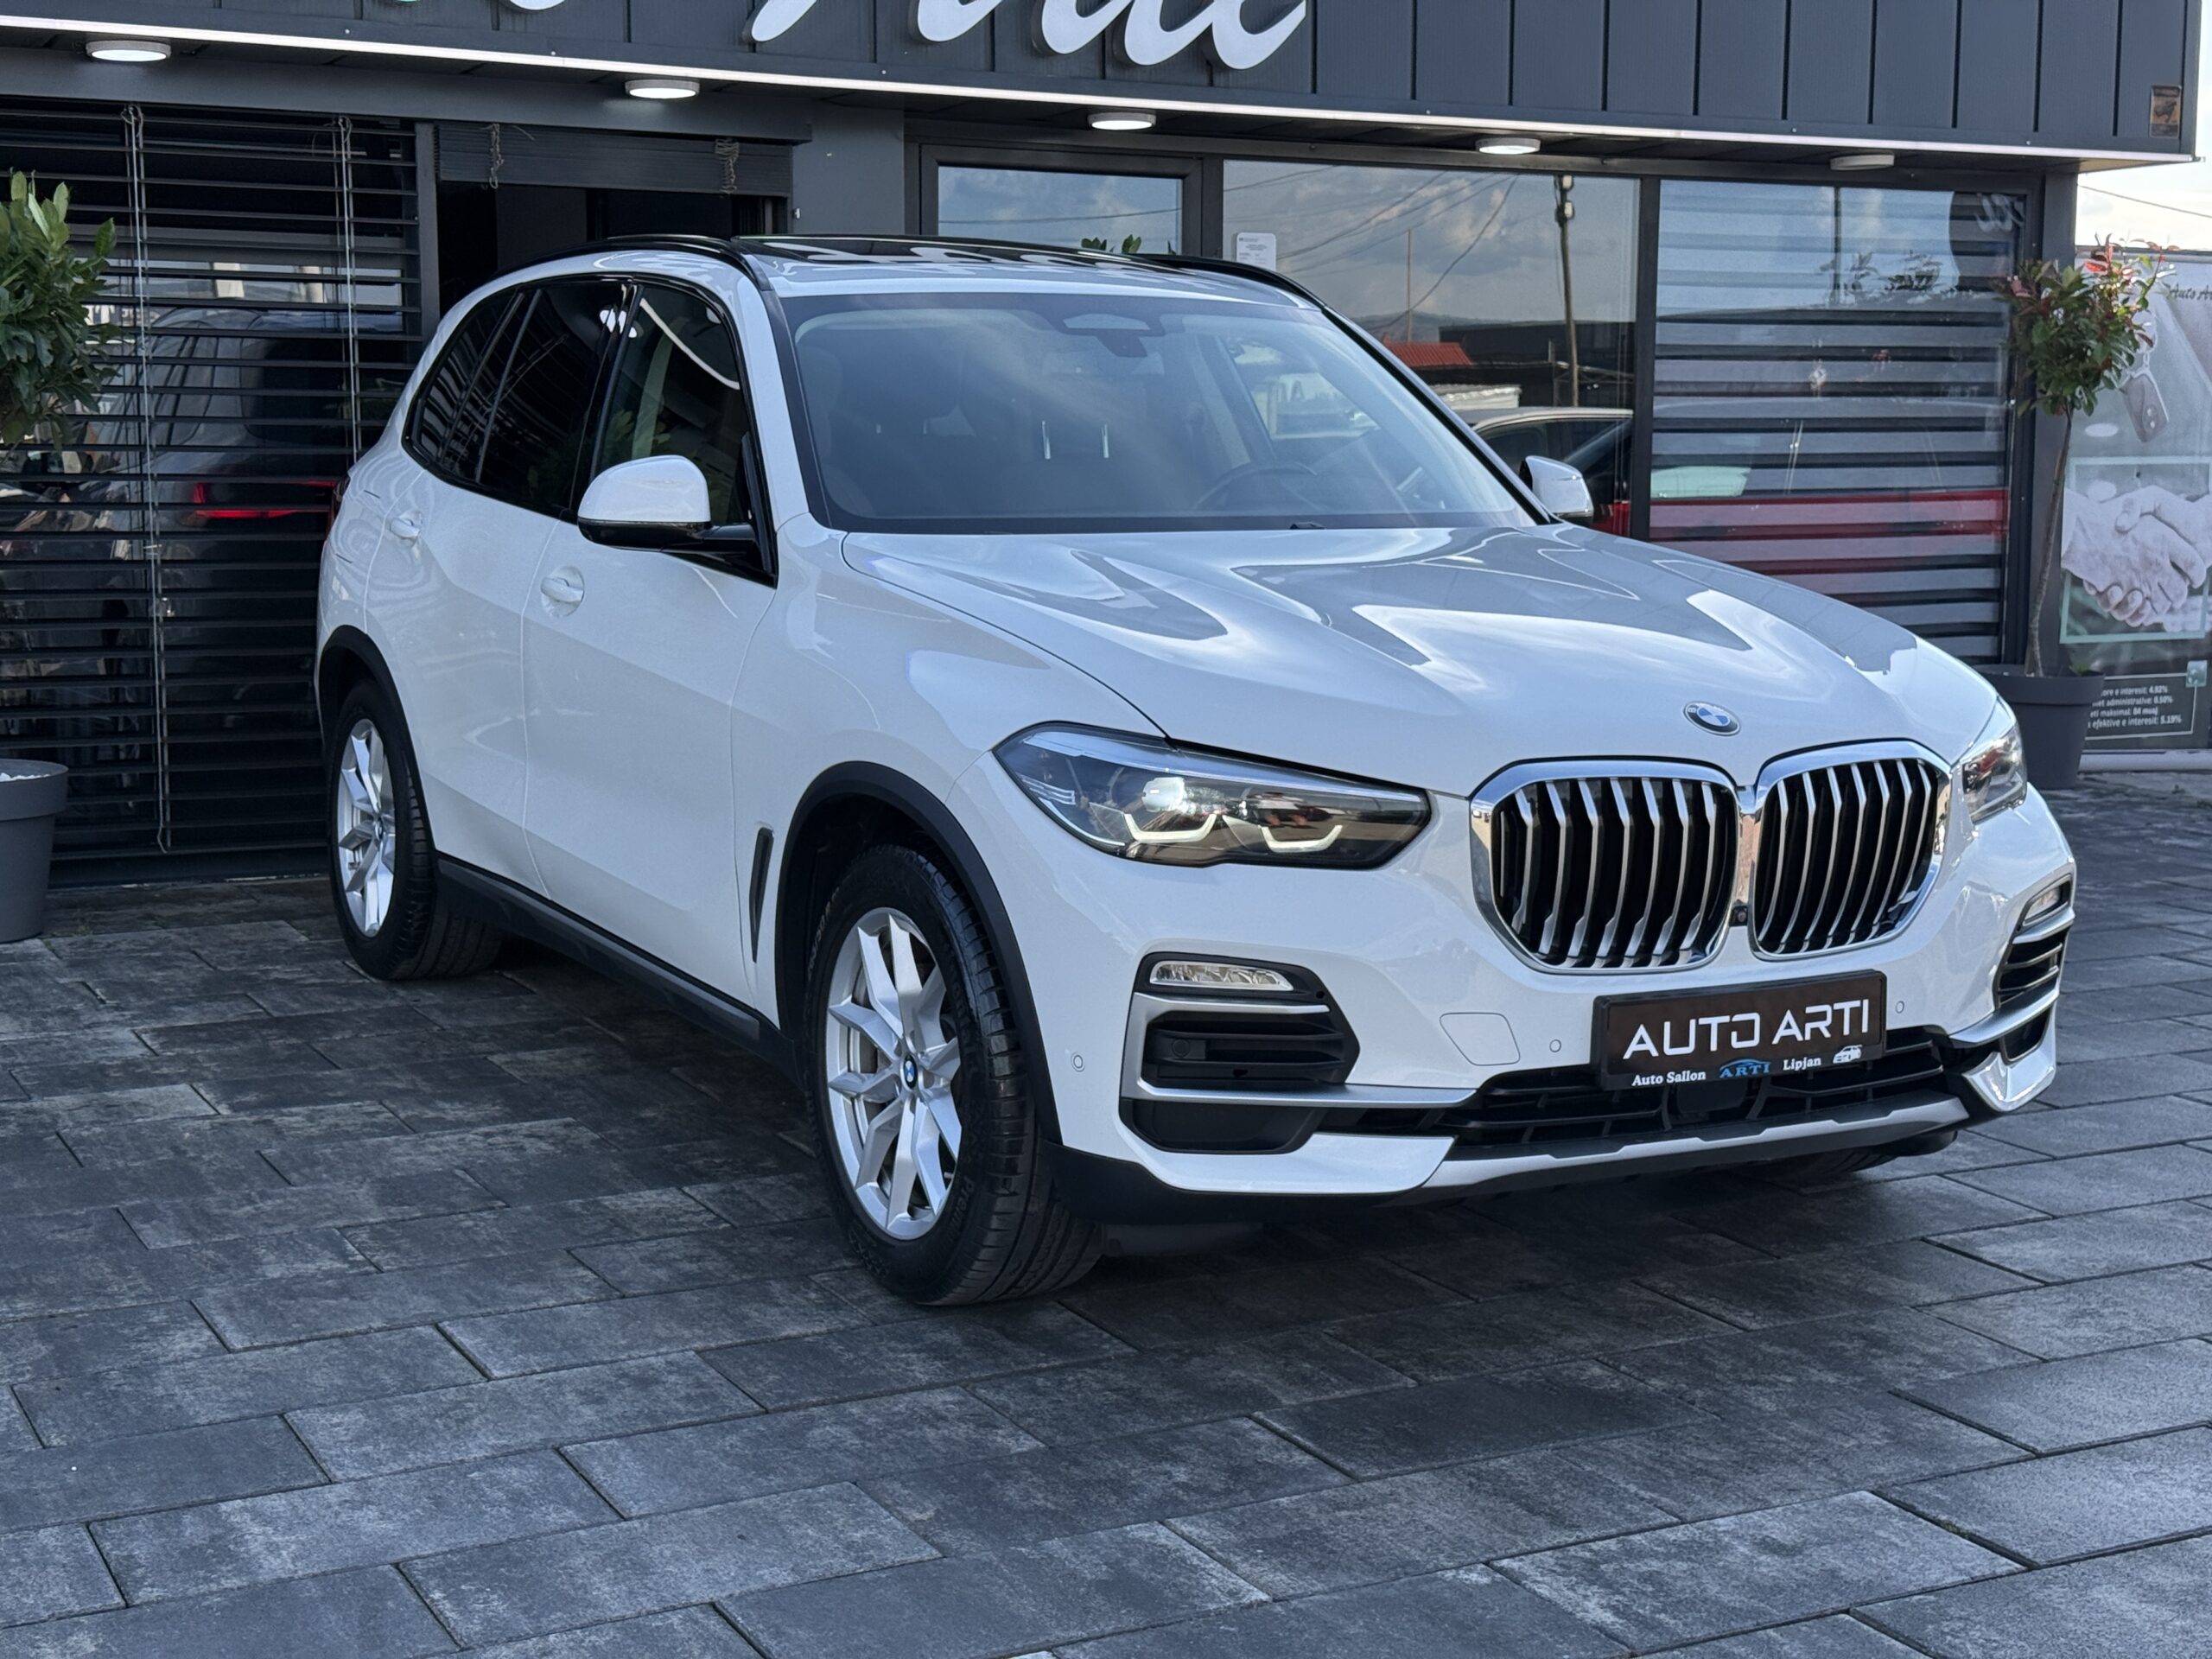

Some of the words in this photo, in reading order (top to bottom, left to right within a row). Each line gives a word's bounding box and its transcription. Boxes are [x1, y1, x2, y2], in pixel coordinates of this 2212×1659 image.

[1623, 1012, 1761, 1059] AUTO
[1771, 999, 1869, 1045] ARTI
[1631, 1073, 1663, 1086] Auto
[1719, 1061, 1771, 1078] ARTI
[1783, 1057, 1821, 1071] Lipjan
